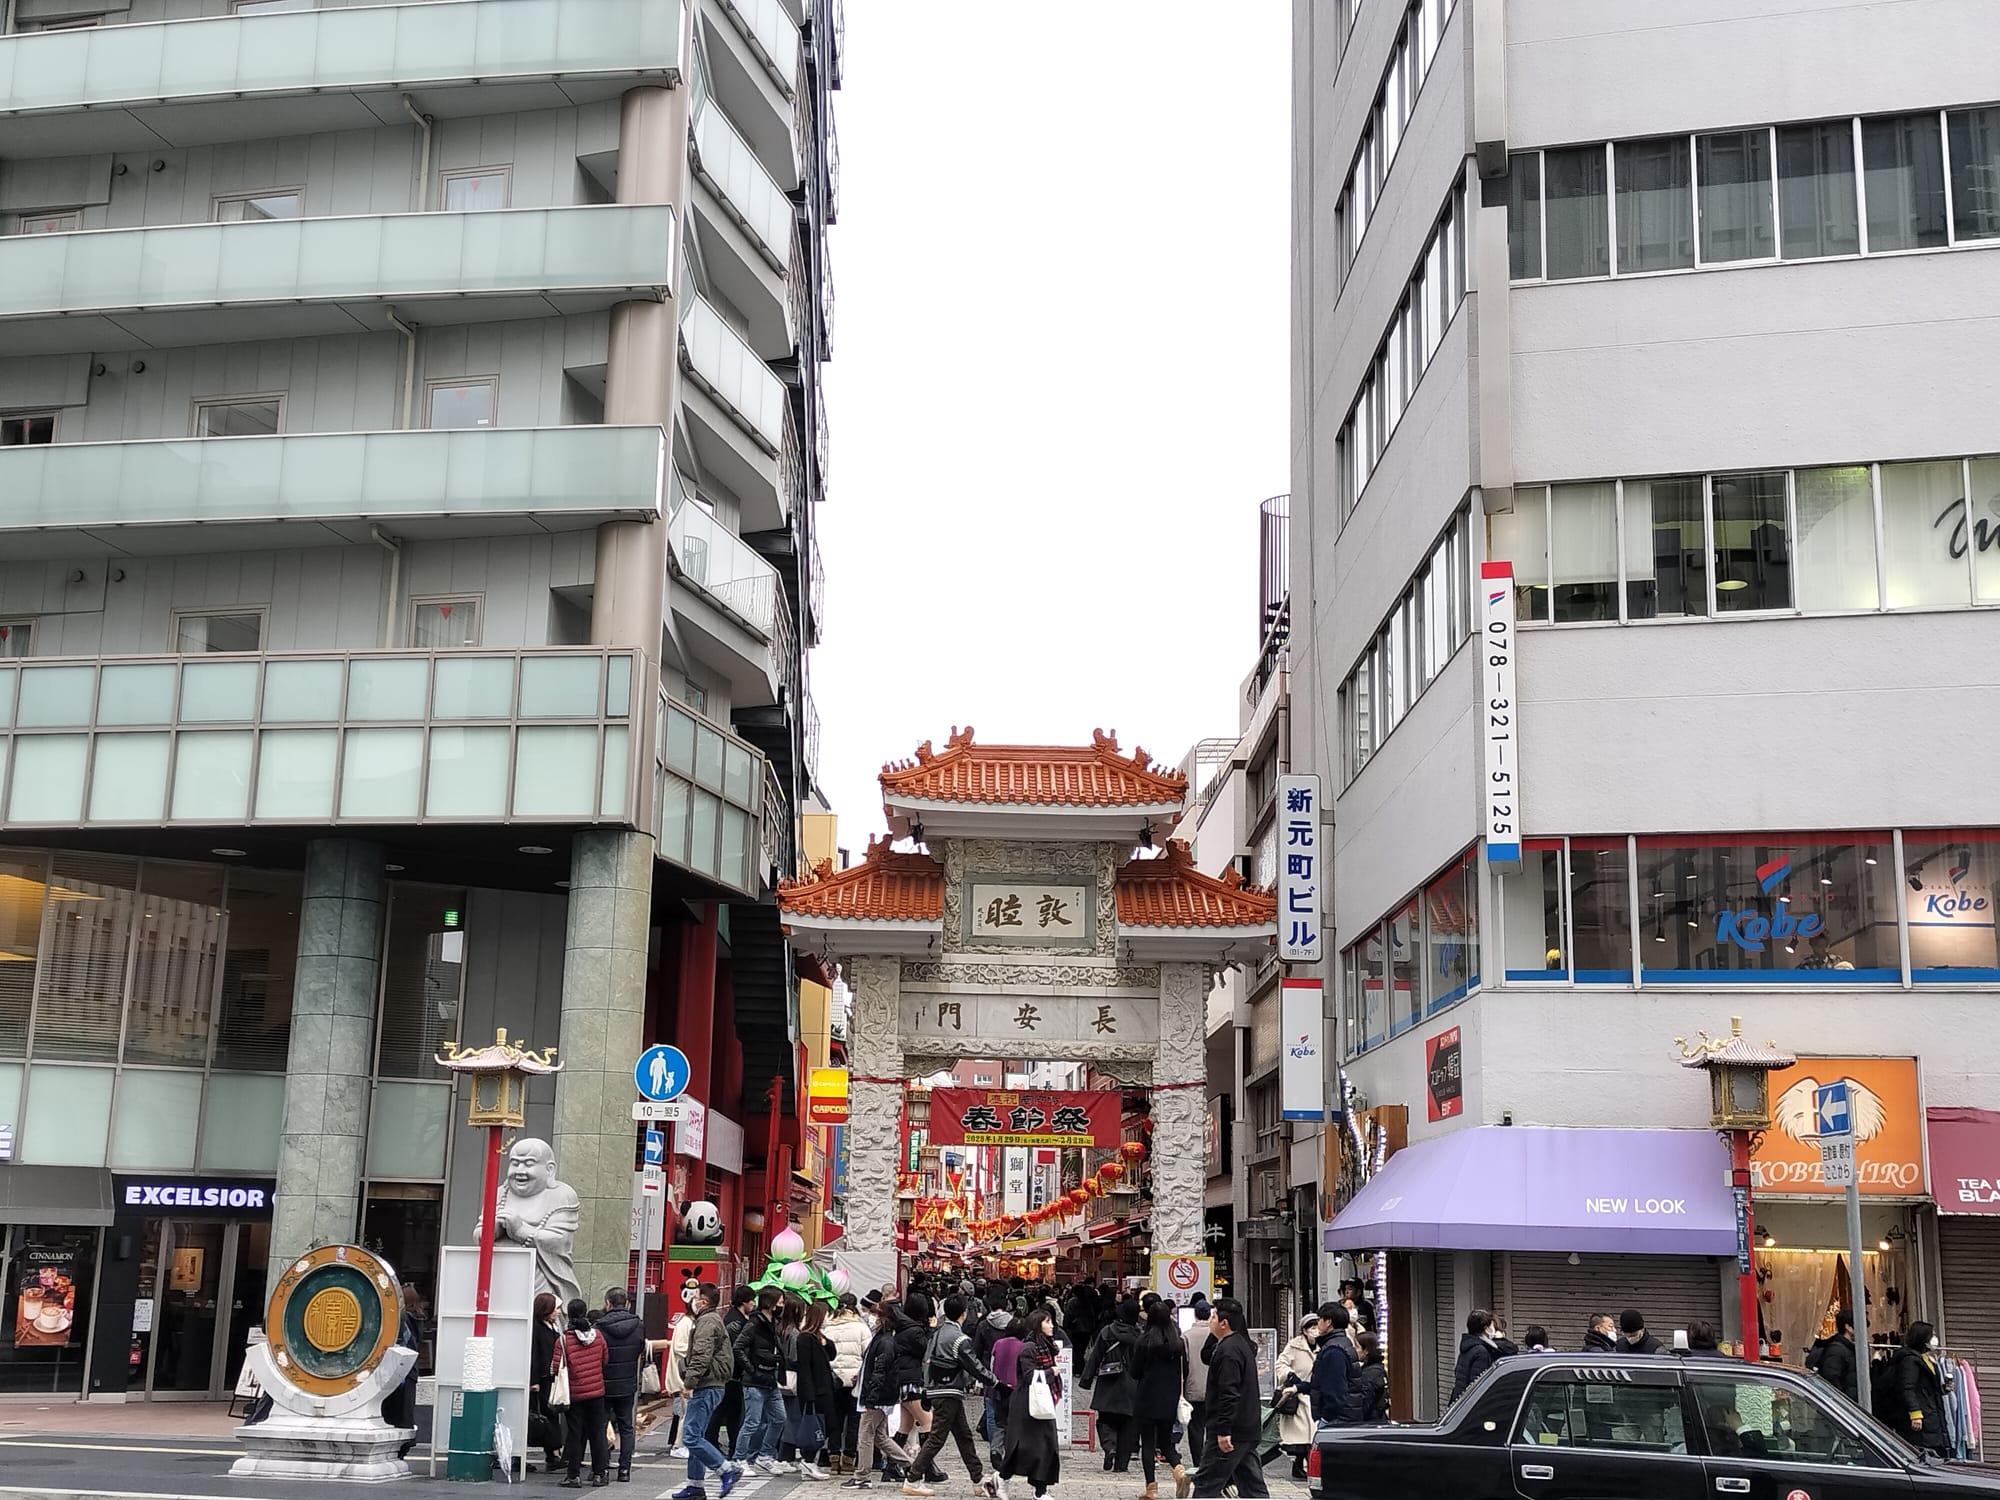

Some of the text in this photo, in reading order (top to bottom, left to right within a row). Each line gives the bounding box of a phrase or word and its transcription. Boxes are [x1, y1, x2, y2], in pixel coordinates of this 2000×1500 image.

[1287, 787, 1317, 947] 新元町ビル
[1926, 890, 1989, 918] Kobe
[1714, 901, 1825, 950] Kobe
[1290, 1047, 1317, 1059] Kobe
[960, 1105, 1091, 1134] 春節祭
[1749, 1160, 1824, 1188] KOBE
[1956, 1178, 1992, 1190] TEA
[125, 1186, 265, 1208] EXCELSIOR
[1586, 1197, 1686, 1215] NEW LOOK
[28, 1251, 74, 1261] CINNAMON
